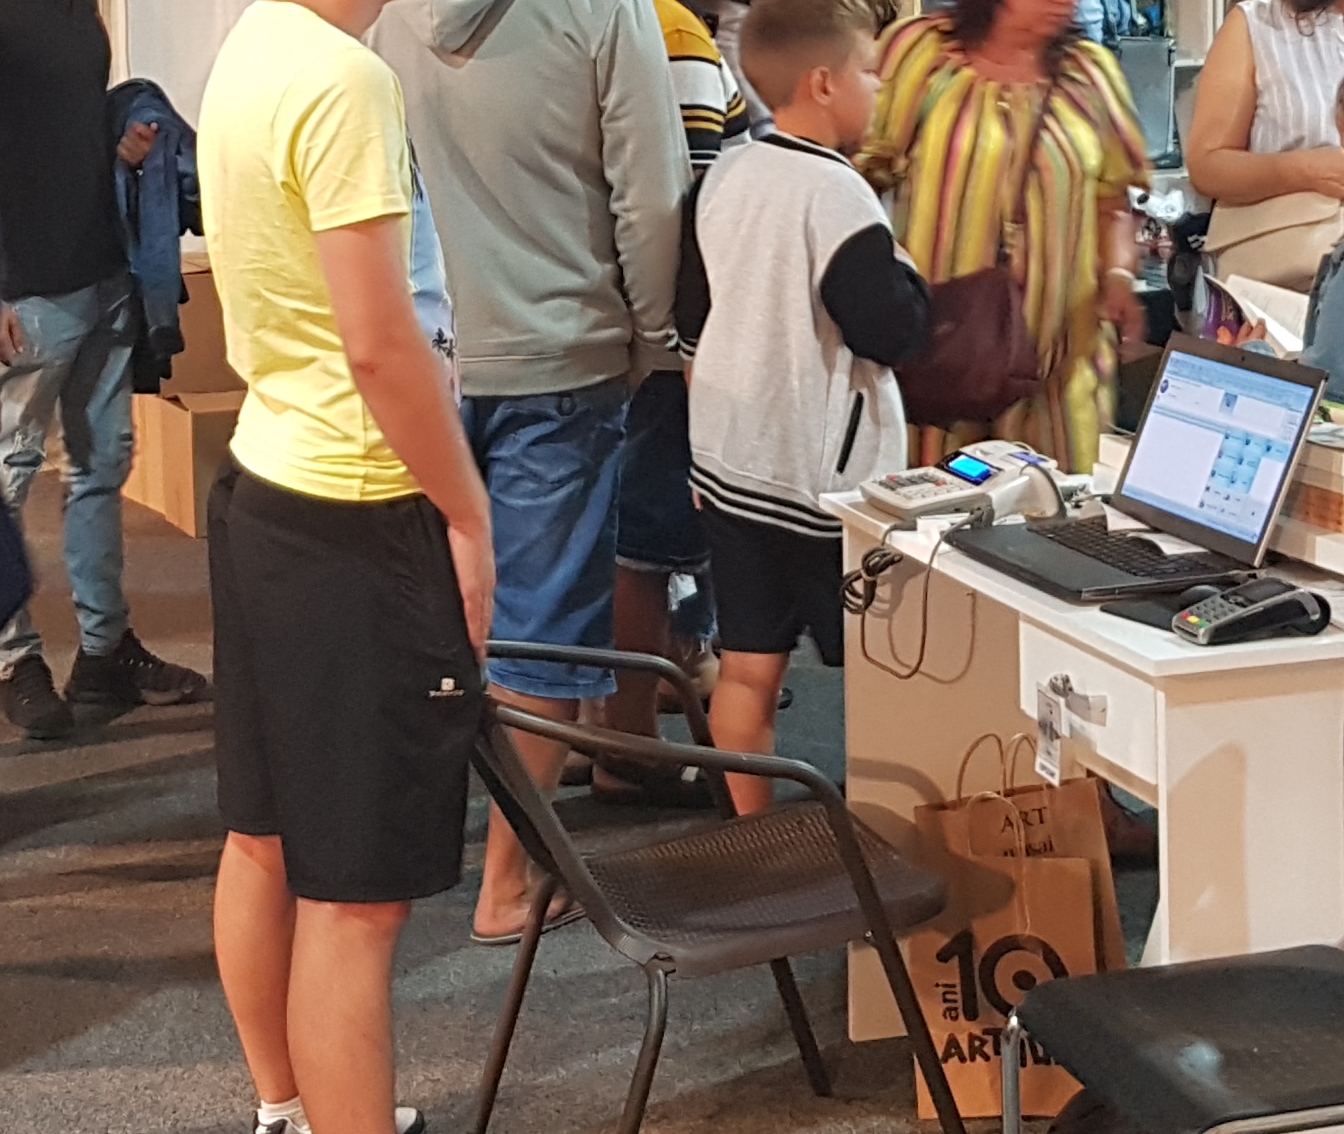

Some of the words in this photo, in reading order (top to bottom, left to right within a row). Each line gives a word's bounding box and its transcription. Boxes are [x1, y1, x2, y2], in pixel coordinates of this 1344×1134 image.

[1001, 806, 1048, 834] ART
[936, 928, 1070, 1023] 10
[934, 981, 960, 1022] ani
